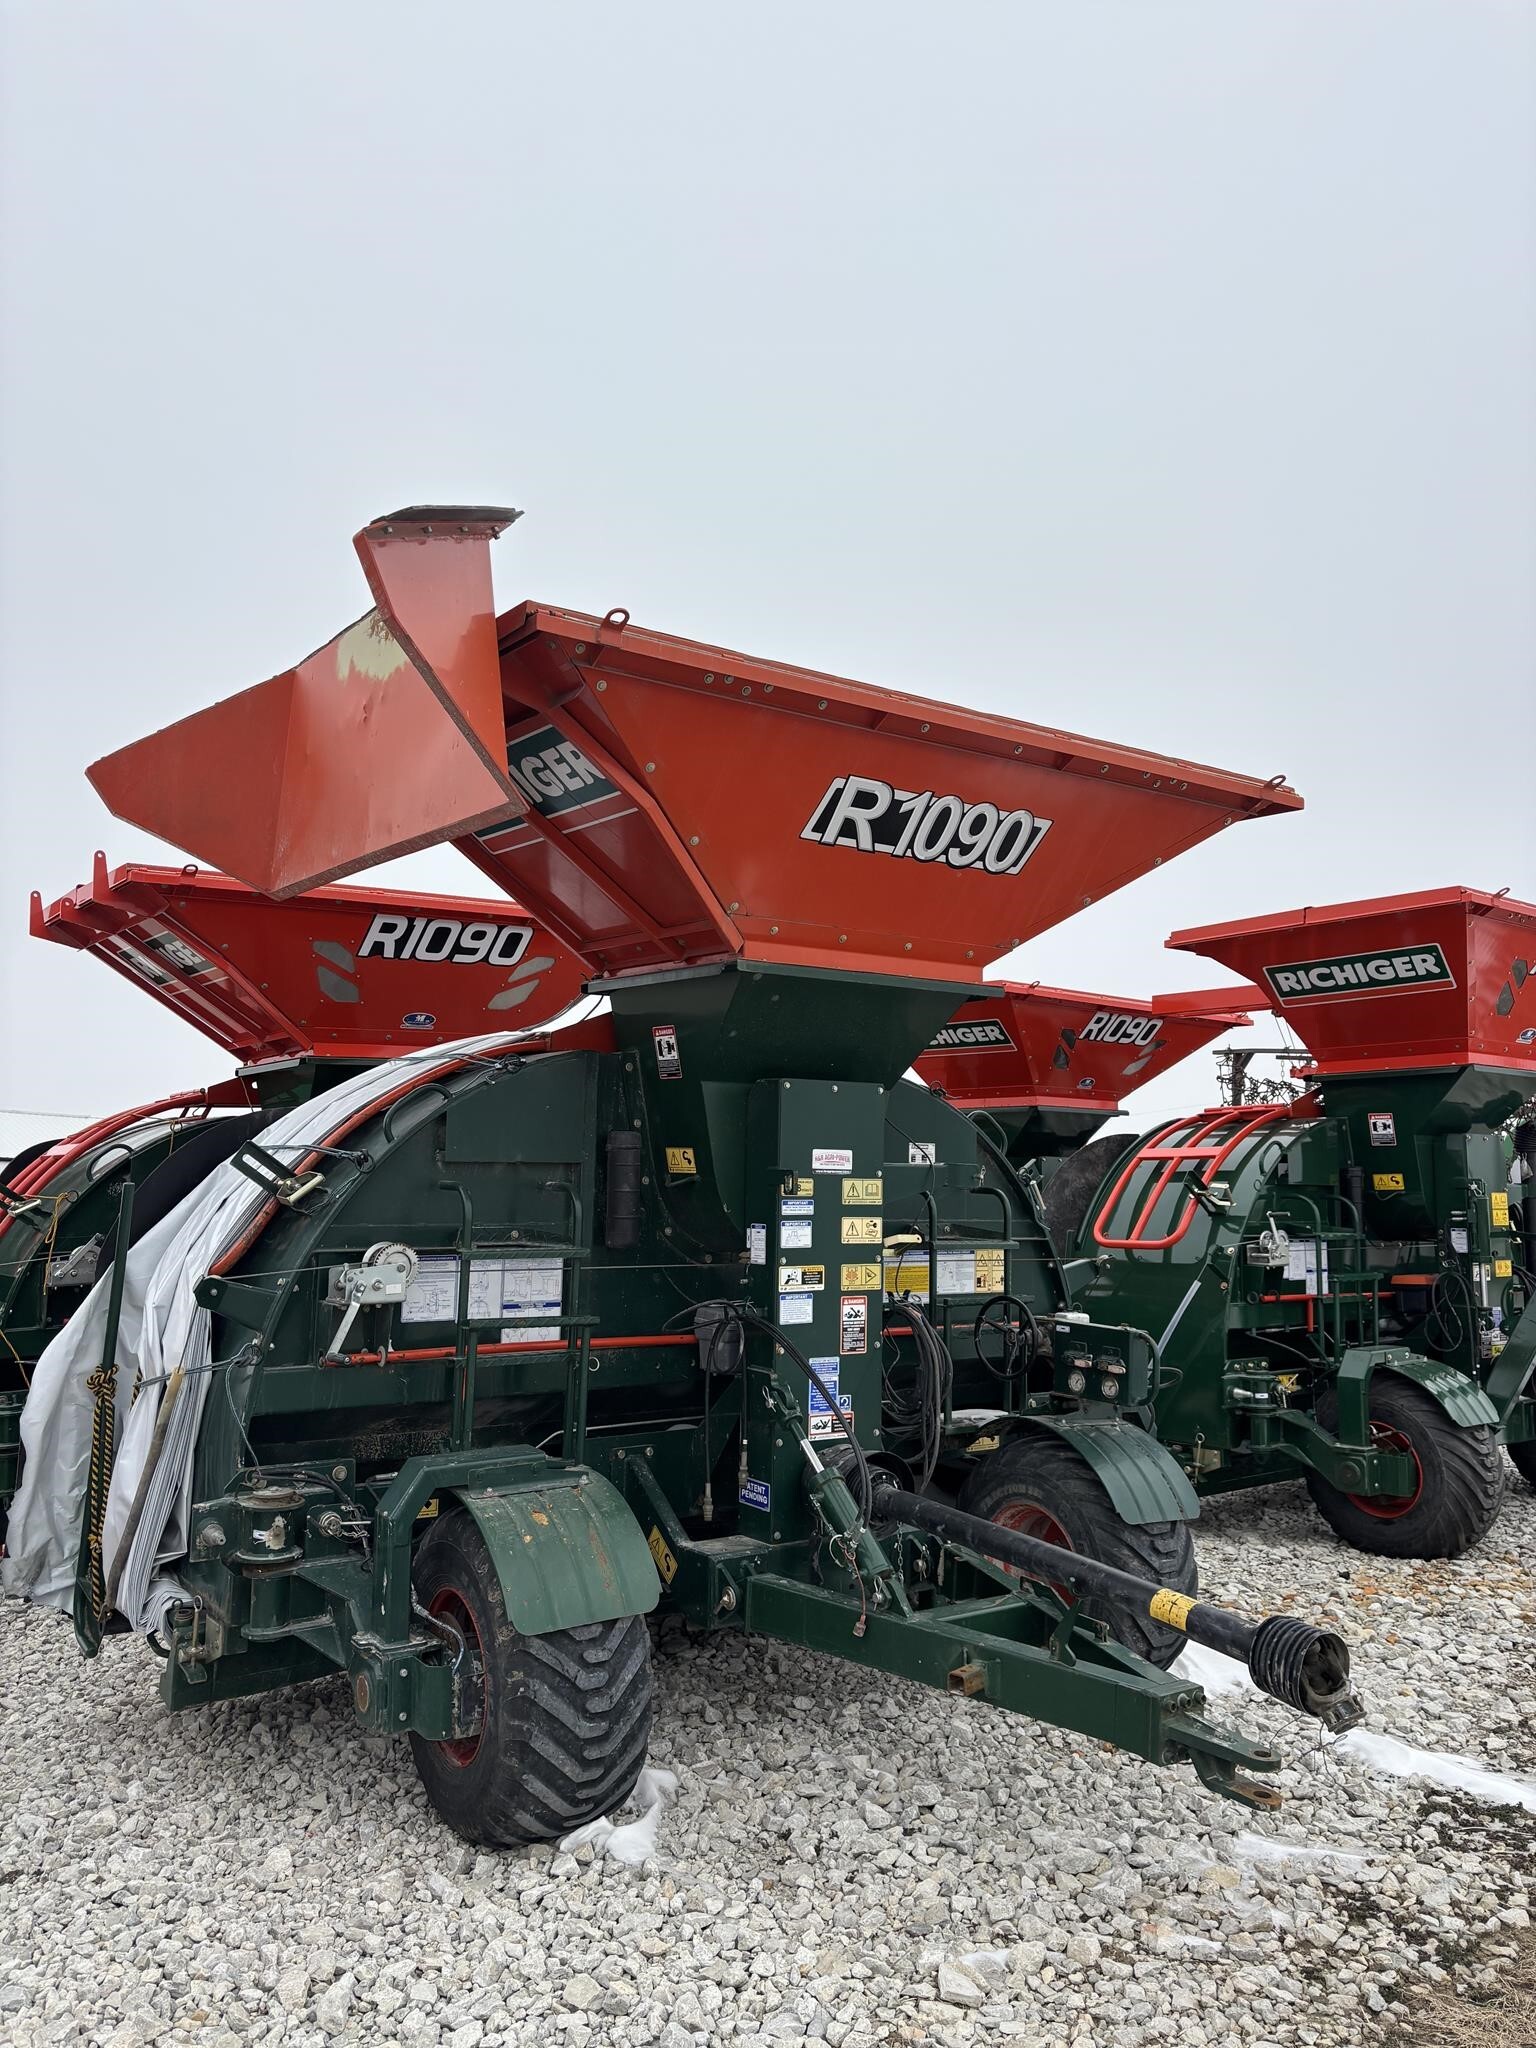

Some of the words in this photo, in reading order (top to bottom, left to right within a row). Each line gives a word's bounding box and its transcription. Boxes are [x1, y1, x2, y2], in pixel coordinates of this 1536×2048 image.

[357, 914, 534, 967] R1090
[1274, 954, 1441, 993] RICHIGER
[1078, 1011, 1164, 1047] R1090
[741, 1488, 768, 1505] PENDING
[746, 1481, 766, 1495] ATENT
